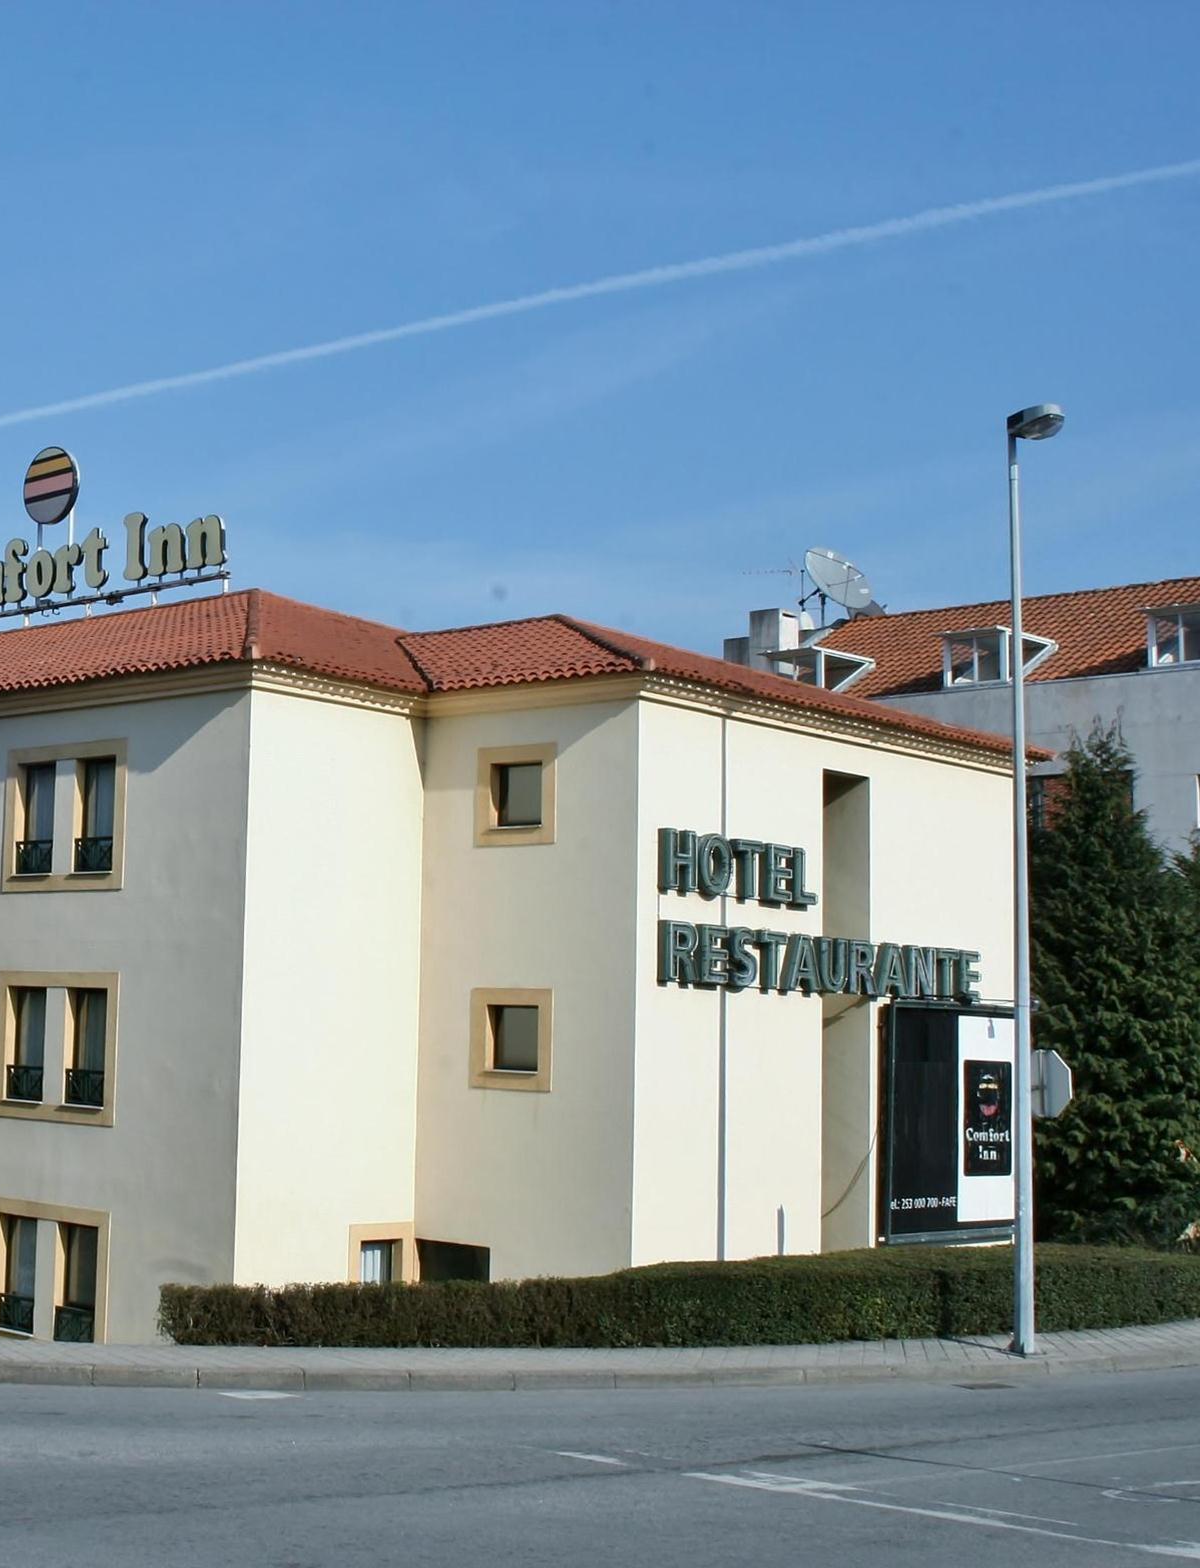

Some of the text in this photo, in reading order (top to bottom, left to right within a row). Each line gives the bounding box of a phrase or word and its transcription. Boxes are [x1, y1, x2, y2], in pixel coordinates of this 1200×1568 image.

[123, 511, 228, 581] Inn
[657, 827, 818, 907] HOTEL
[657, 919, 983, 1002] RESTAURANTE
[965, 1127, 1010, 1142] Comfort
[978, 1145, 997, 1160] Inn
